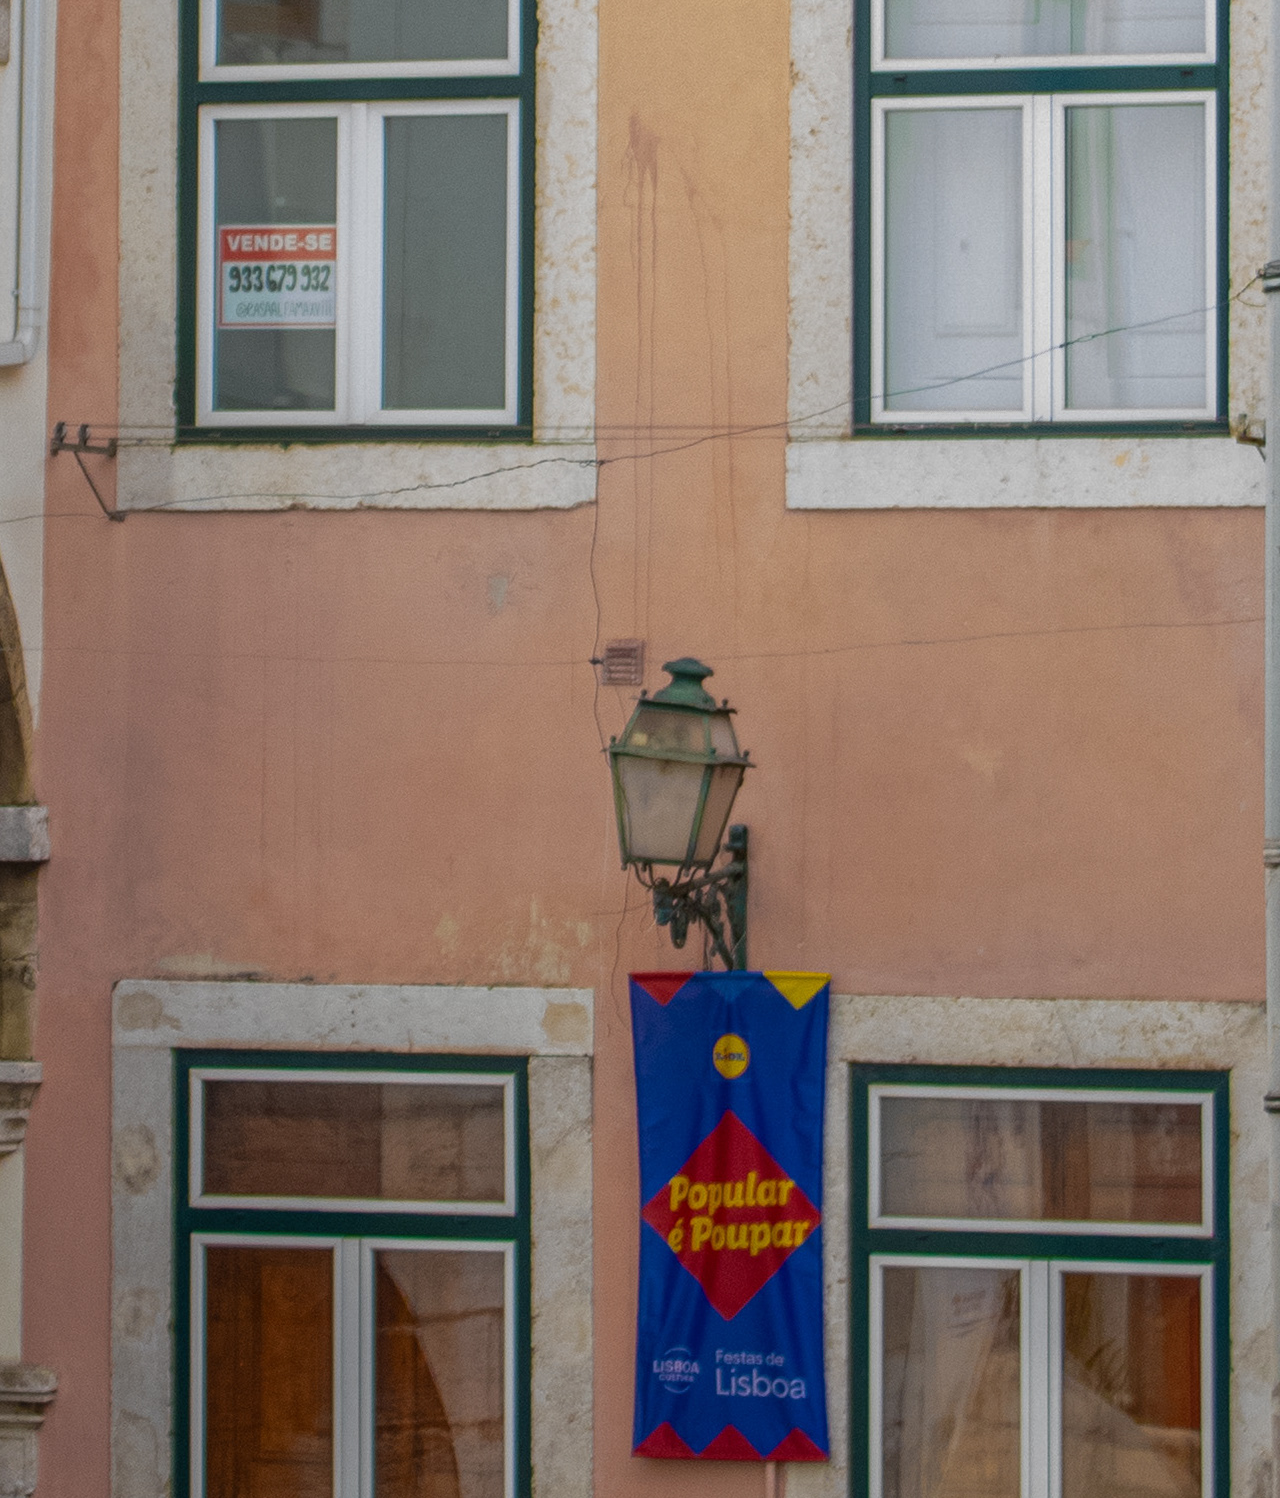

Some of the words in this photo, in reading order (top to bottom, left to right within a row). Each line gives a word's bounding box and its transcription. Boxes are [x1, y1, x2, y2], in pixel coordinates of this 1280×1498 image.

[227, 233, 332, 252] VENDE-SE
[228, 265, 263, 293] 933
[300, 264, 331, 292] 932
[669, 1170, 795, 1216] Popular
[668, 1217, 684, 1253] é
[690, 1216, 810, 1256] Poupar
[652, 1359, 701, 1374] LISBOA
[715, 1349, 762, 1365] Festas
[765, 1352, 785, 1366] de
[715, 1367, 807, 1400] Lisboa
